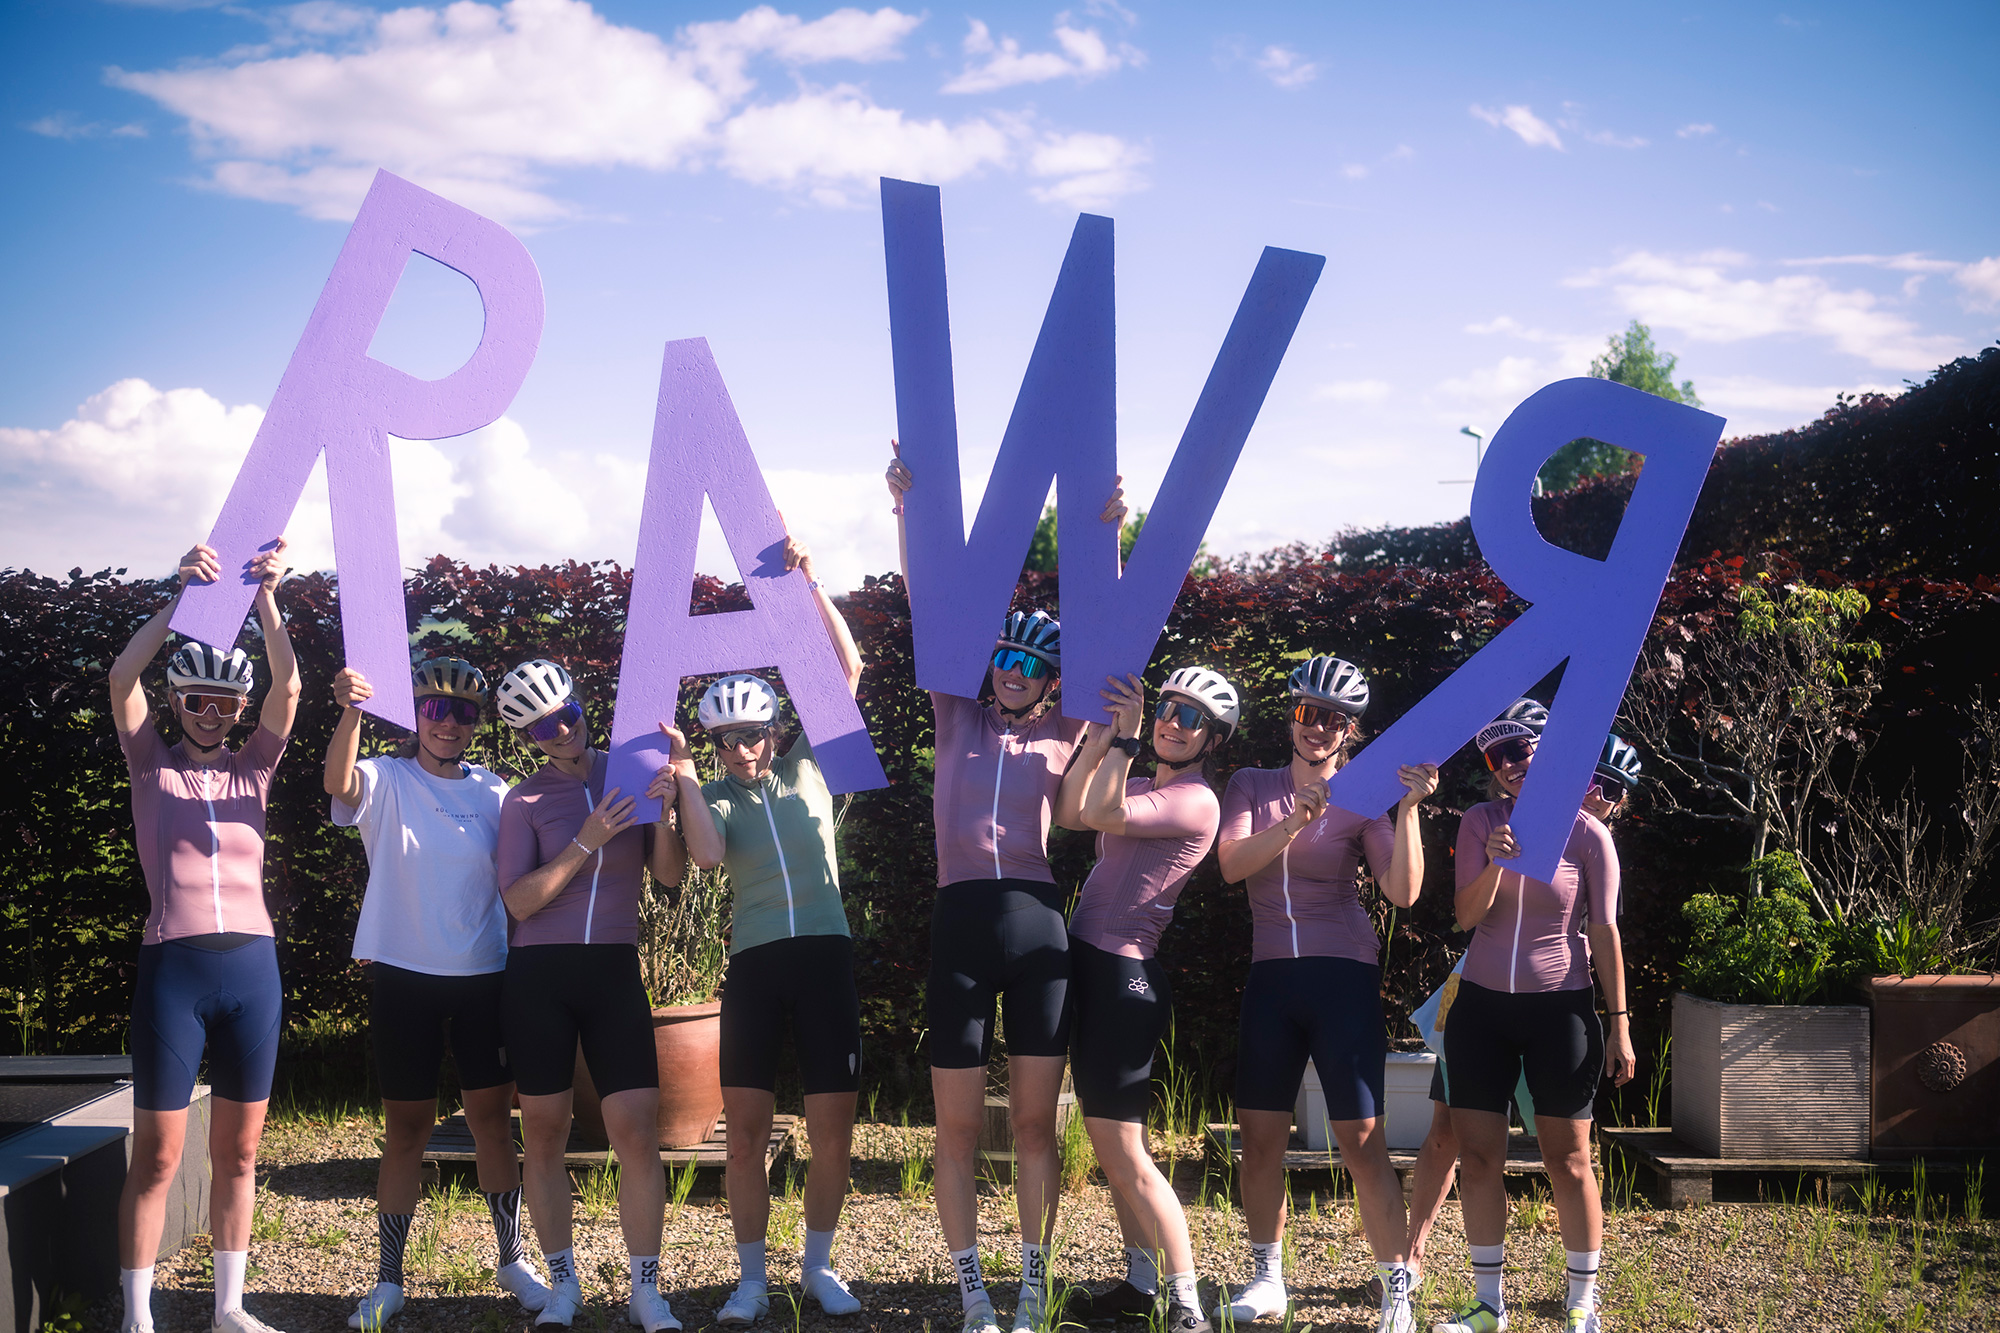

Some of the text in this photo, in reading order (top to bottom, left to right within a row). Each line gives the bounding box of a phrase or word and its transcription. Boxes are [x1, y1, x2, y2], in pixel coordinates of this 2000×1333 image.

[170, 167, 1726, 884] RAWR
[641, 1260, 659, 1284] ESS
[958, 1253, 982, 1293] FEAR
[1028, 1249, 1047, 1289] LESS
